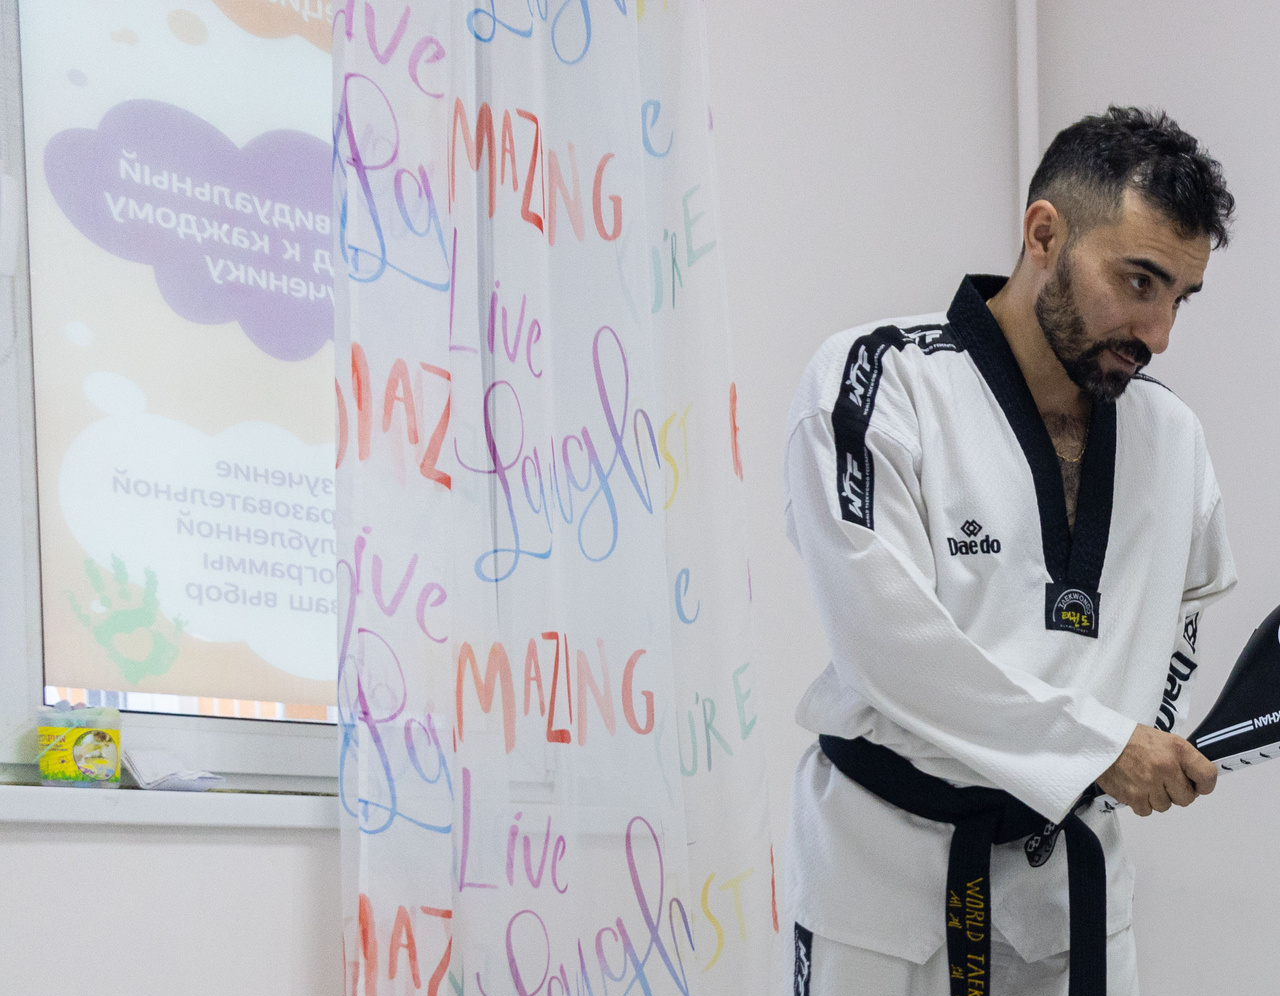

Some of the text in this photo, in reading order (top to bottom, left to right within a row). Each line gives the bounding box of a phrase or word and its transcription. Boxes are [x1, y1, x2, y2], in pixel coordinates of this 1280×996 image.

[454, 325, 661, 582] Laugh
[1058, 593, 1091, 614] TAEKWONDO
[460, 767, 568, 894] Live
[966, 877, 985, 942] WORLD
